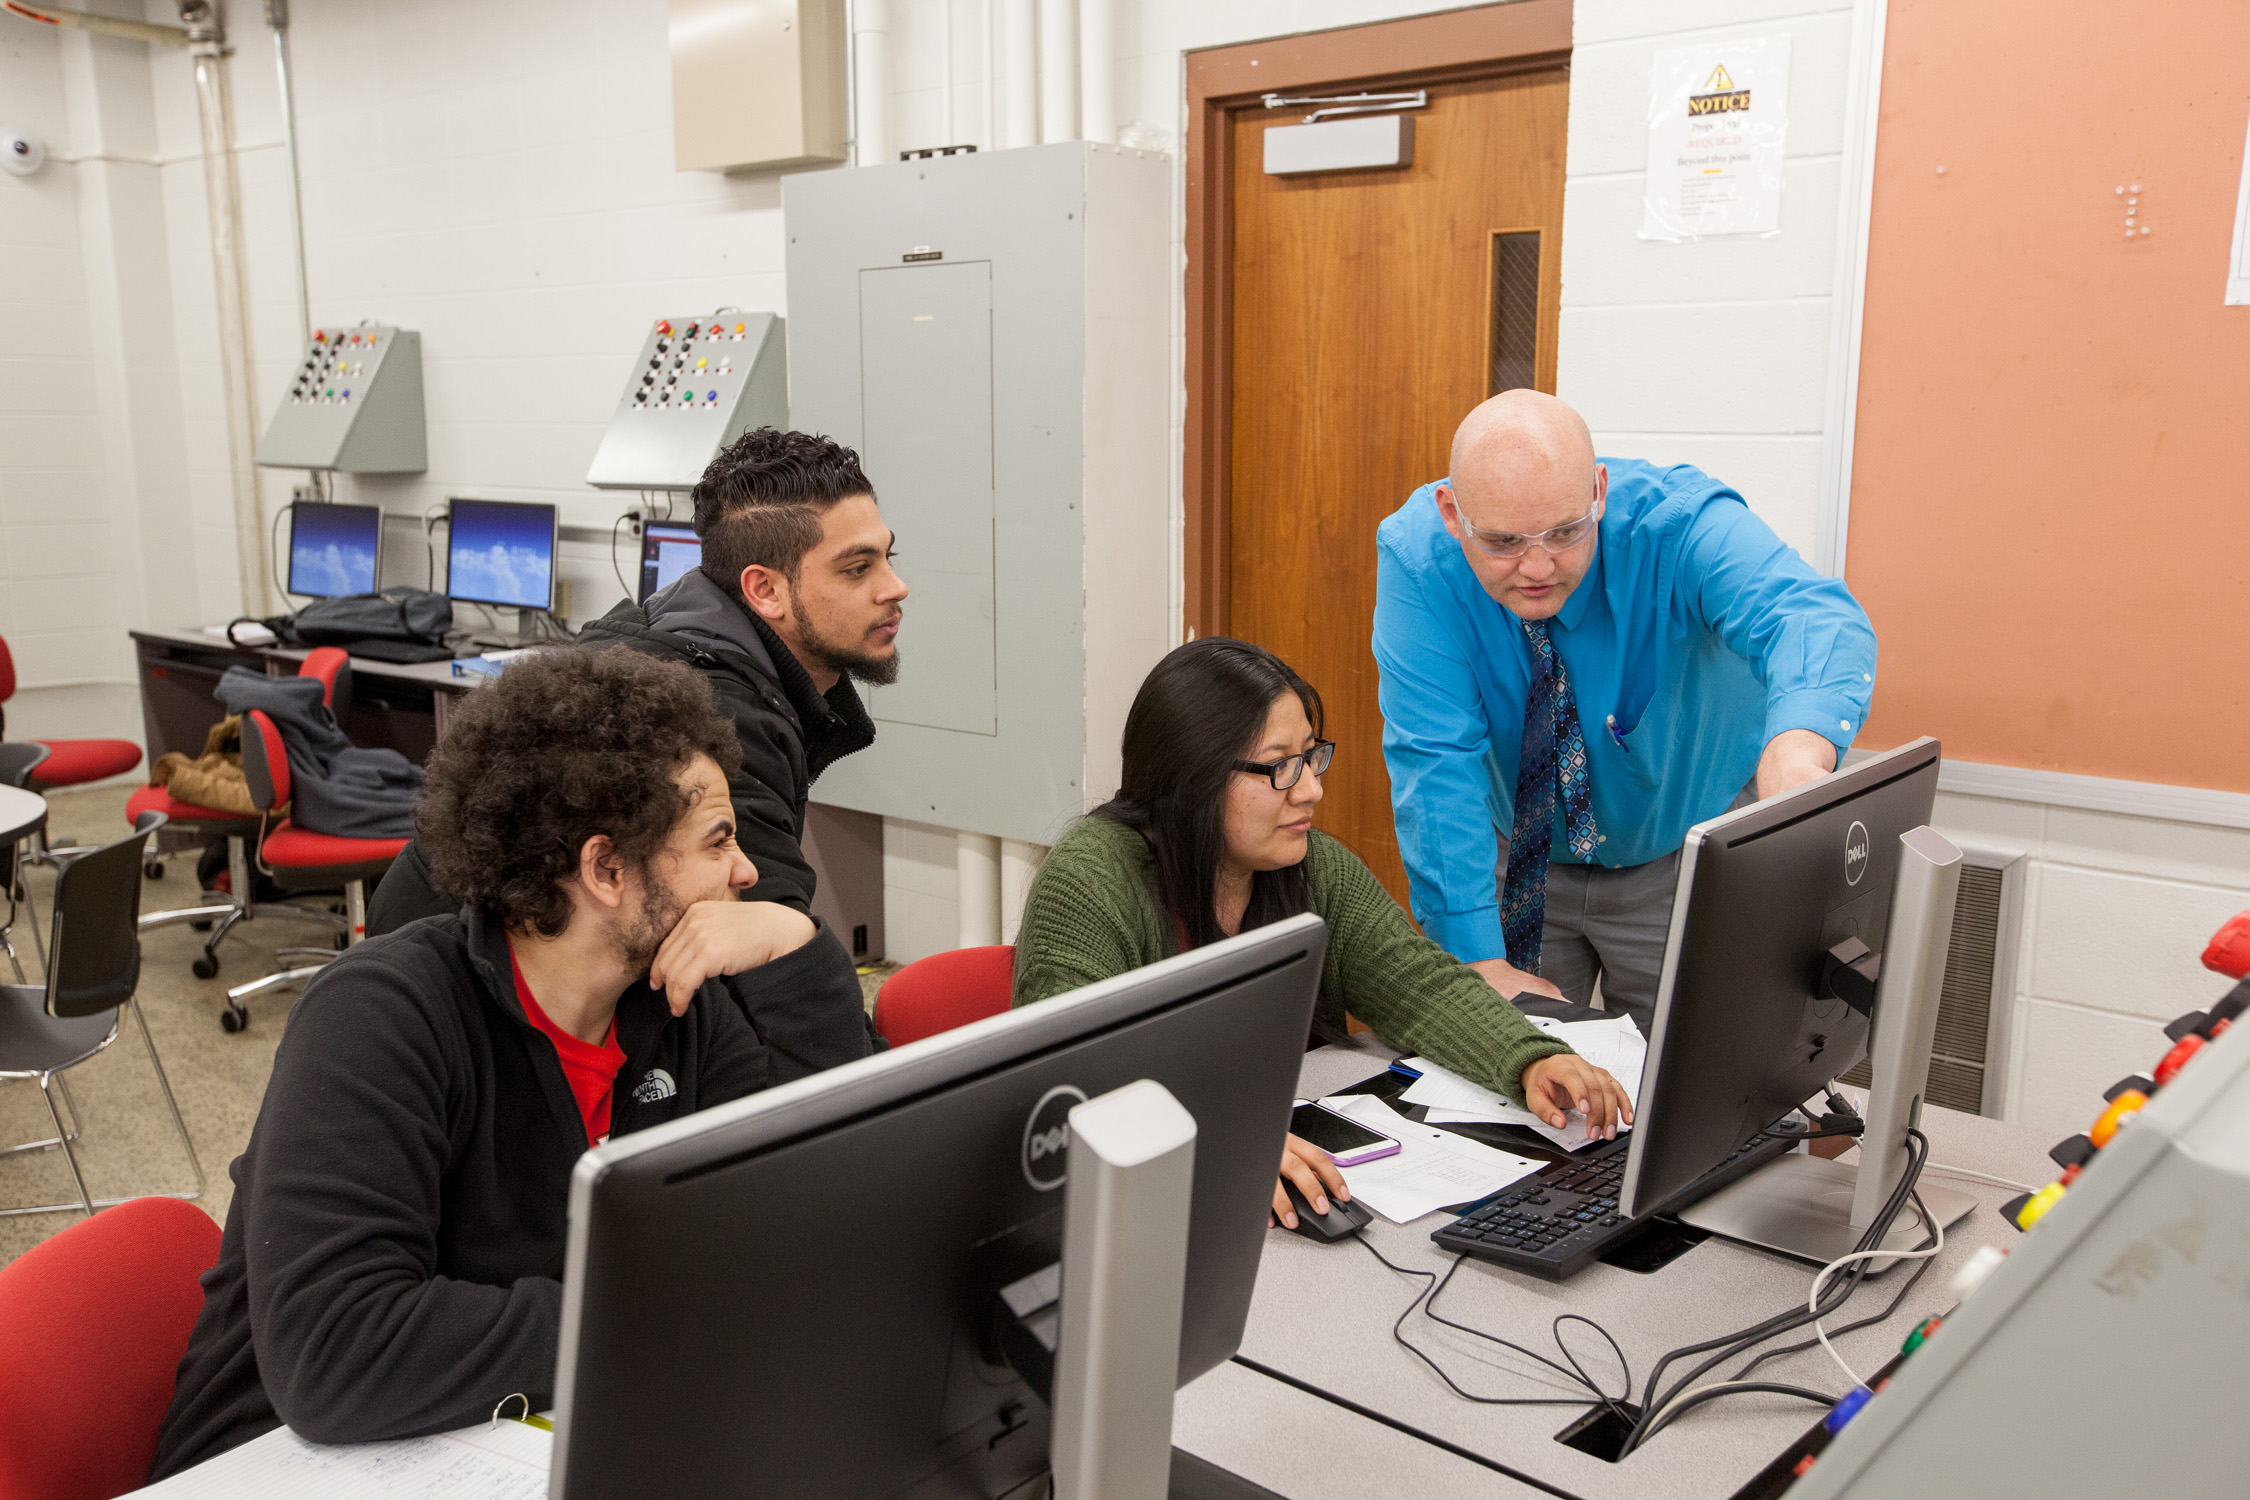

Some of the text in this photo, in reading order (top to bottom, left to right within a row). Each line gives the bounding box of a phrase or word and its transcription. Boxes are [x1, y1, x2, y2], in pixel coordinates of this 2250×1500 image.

[1689, 93, 1749, 114] NOTICE
[1688, 135, 1743, 149] REQUIRD
[1677, 152, 1751, 167] Beyond this point
[1847, 842, 1866, 865] DELL
[1031, 1122, 1069, 1161] DEL
